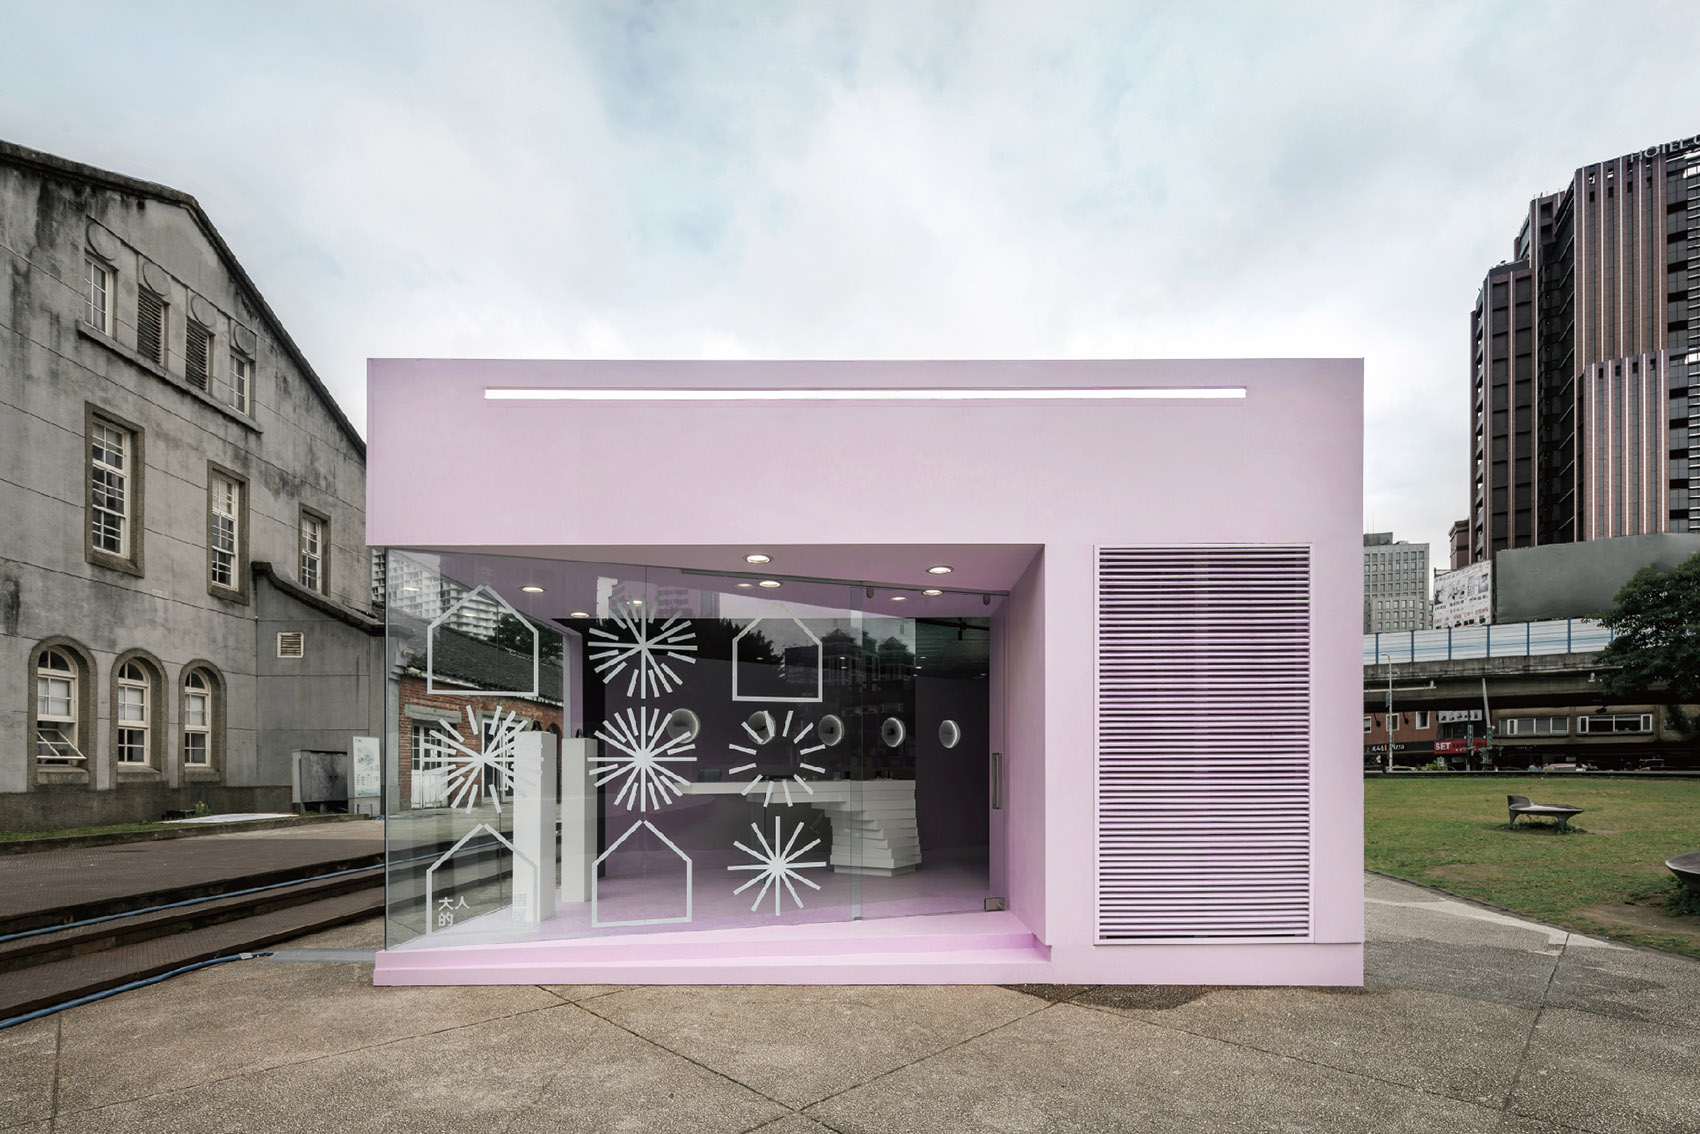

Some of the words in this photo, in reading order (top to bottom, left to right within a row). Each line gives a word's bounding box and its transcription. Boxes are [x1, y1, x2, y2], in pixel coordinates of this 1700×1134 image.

[1630, 139, 1688, 163] HOTEL
[1435, 742, 1451, 751] SET
[438, 895, 470, 911] 大人
[438, 911, 454, 926] 的
